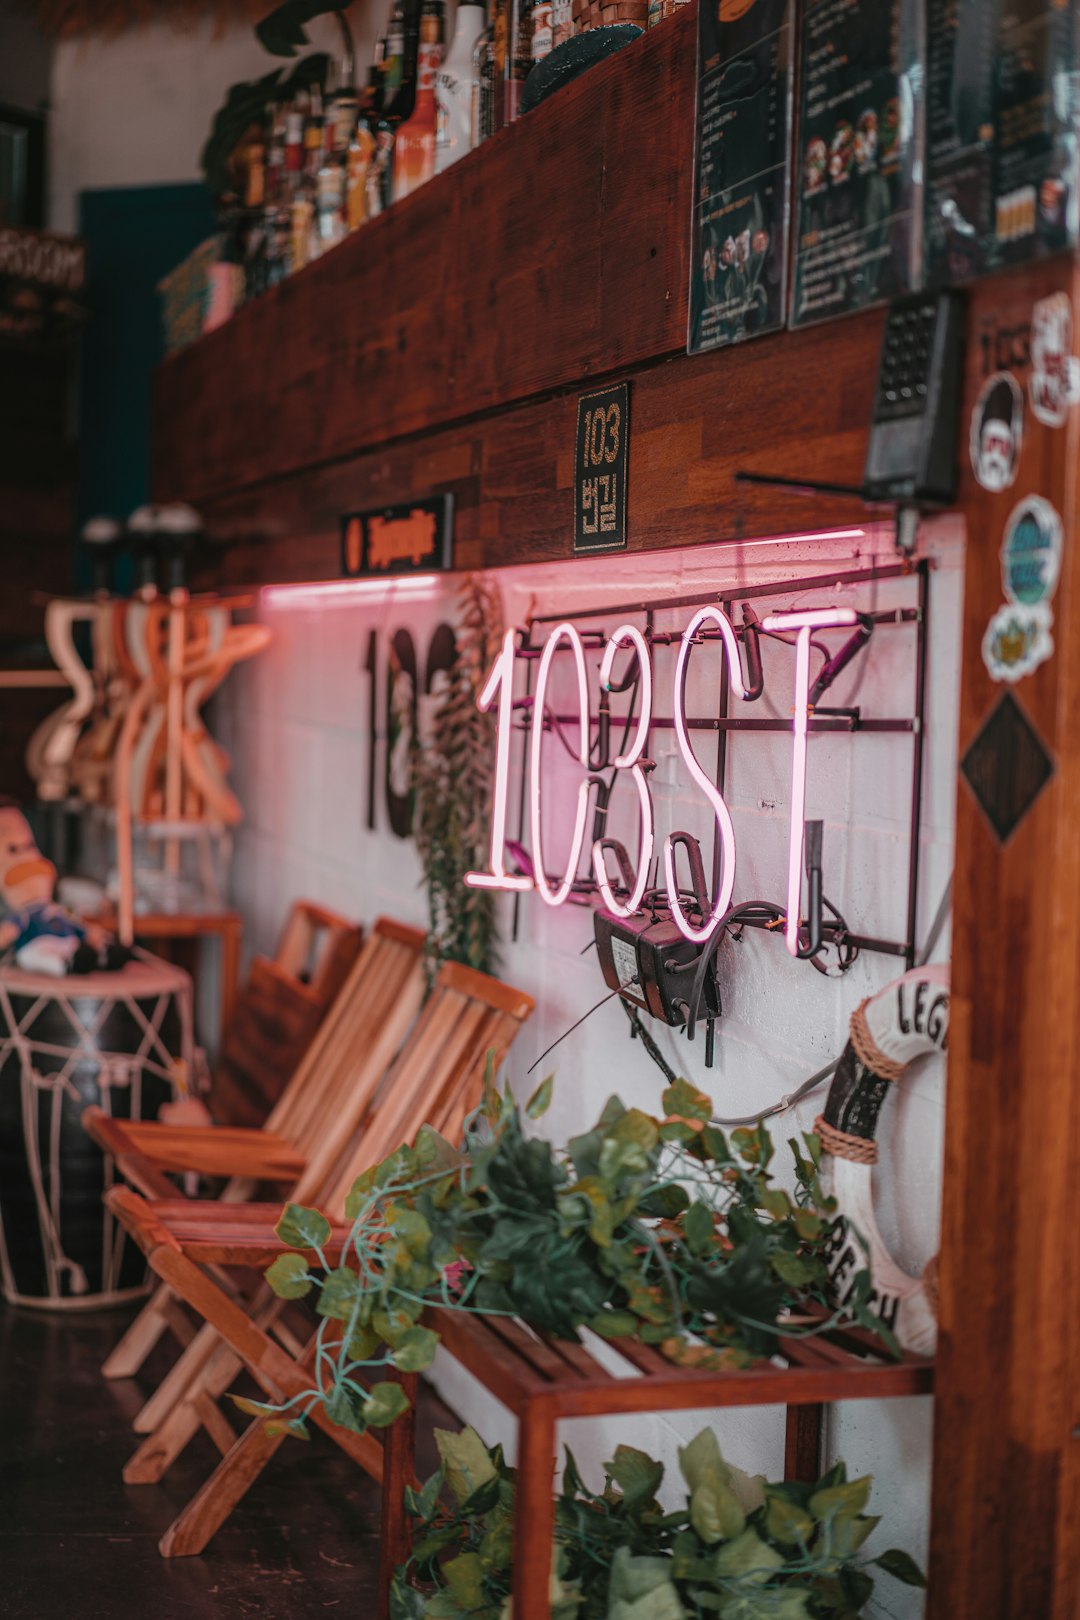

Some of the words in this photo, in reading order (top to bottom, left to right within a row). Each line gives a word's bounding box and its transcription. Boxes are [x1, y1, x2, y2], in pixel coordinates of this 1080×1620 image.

[584, 403, 621, 467] 103
[582, 473, 617, 534] 번길
[897, 979, 949, 1050] LEG
